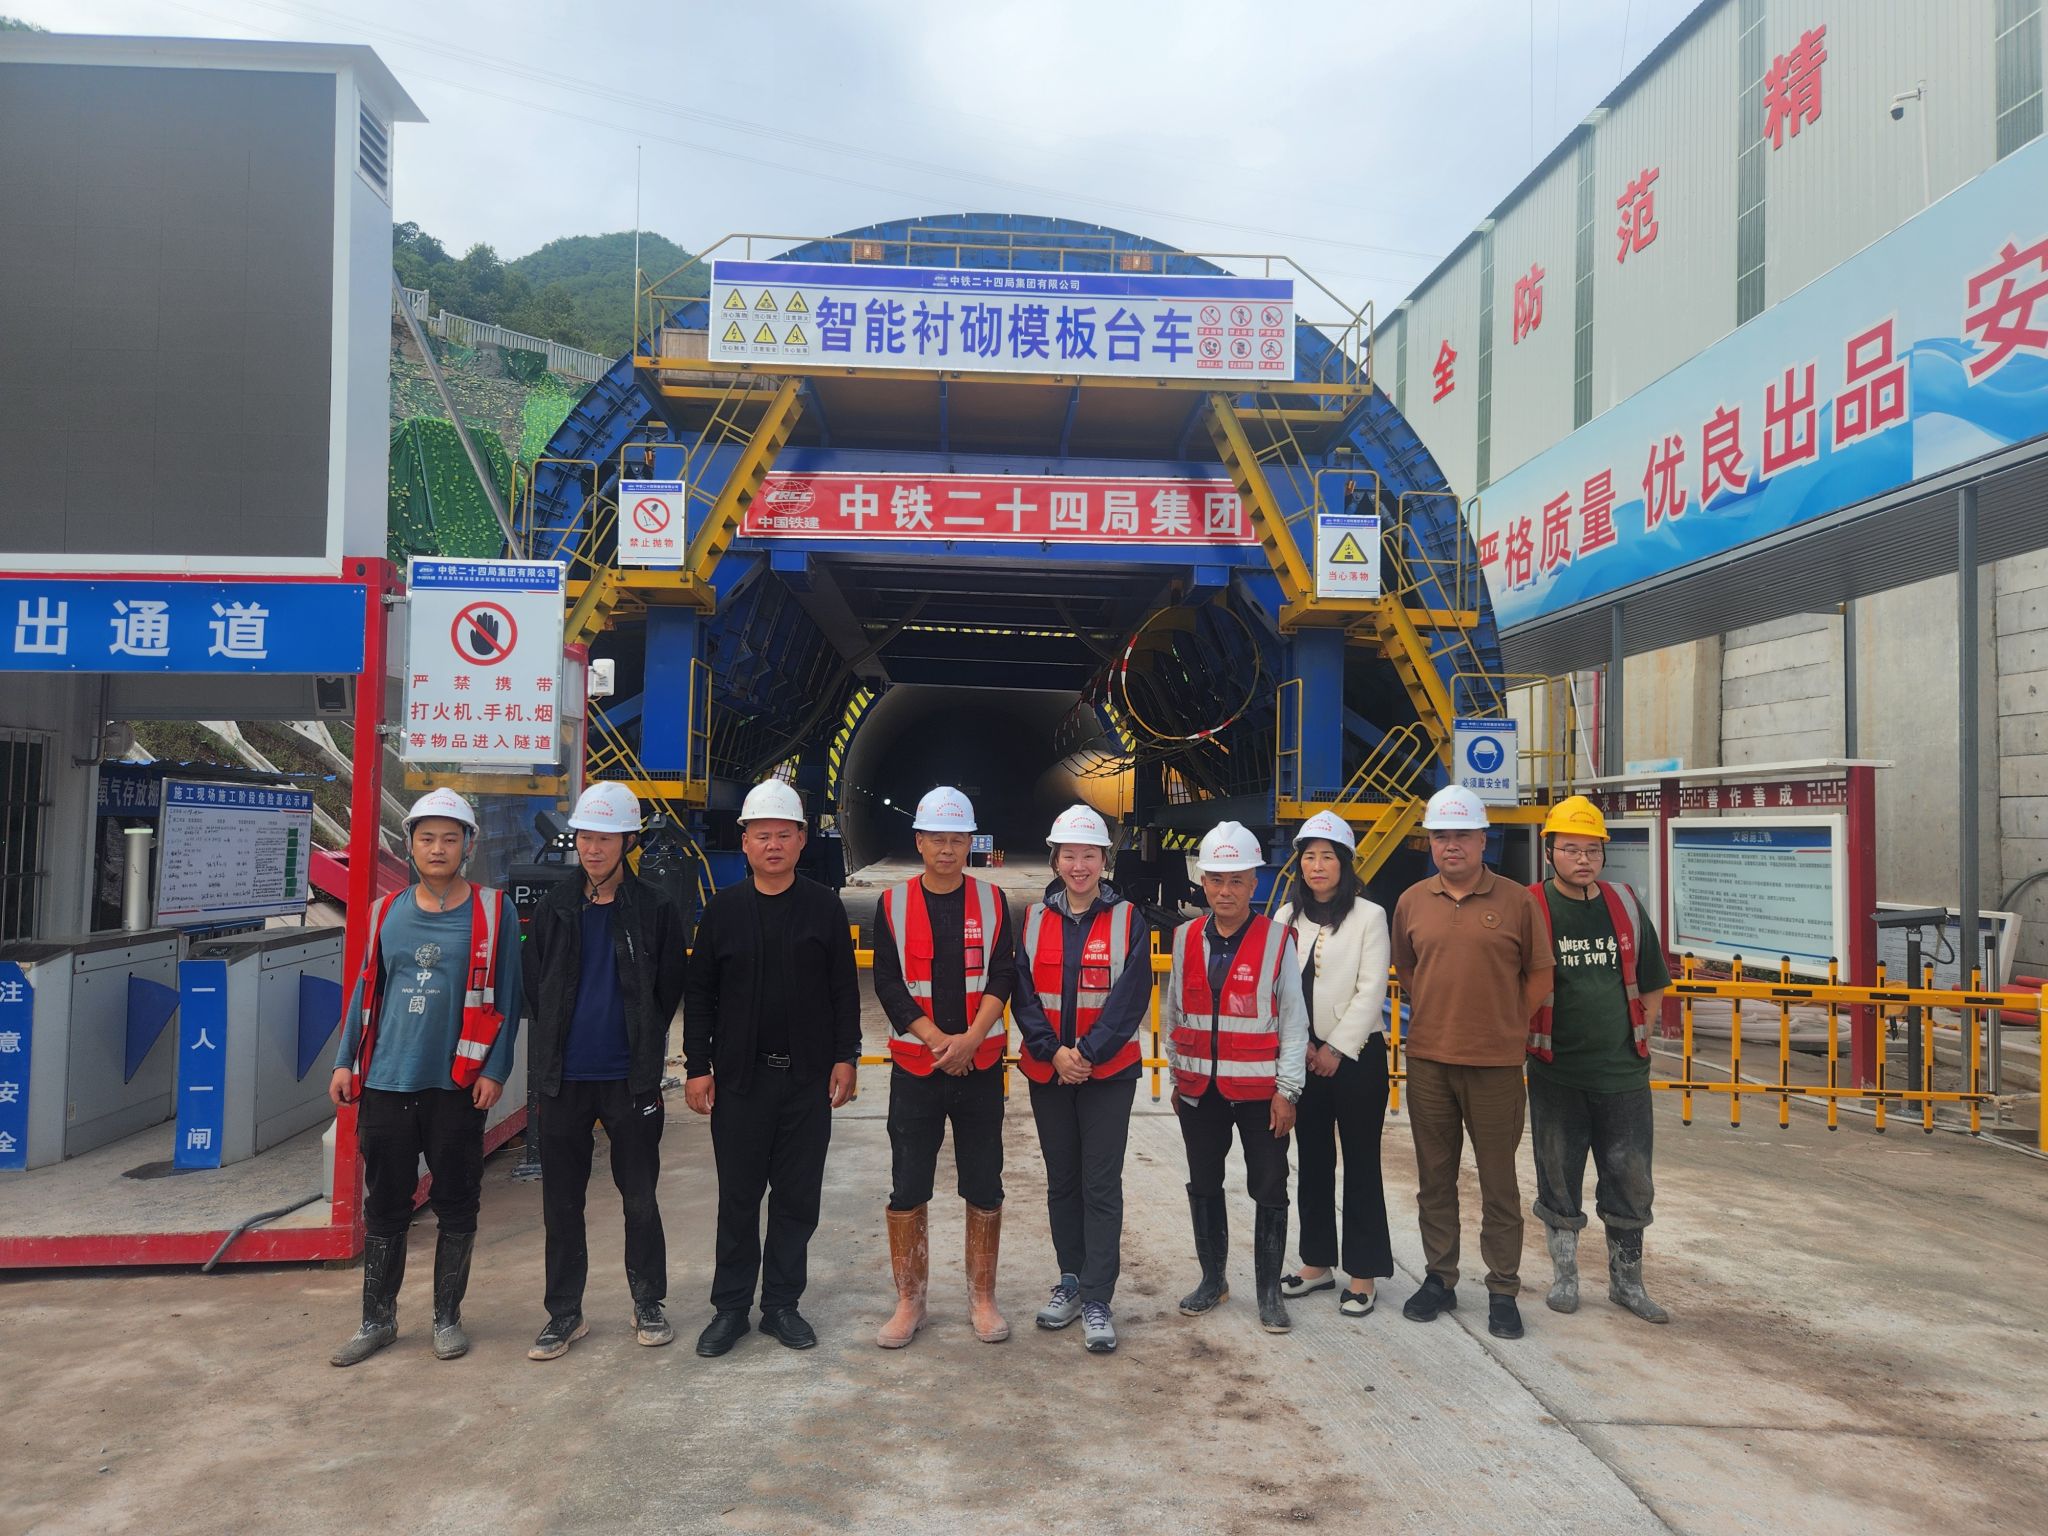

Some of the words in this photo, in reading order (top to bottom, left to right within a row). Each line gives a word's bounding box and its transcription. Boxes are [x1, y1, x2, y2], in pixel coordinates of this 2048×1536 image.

[950, 275, 1080, 291] 中铁二十四局集团有限公司
[815, 295, 1195, 363] 智能衬砌模板台车
[1642, 316, 1906, 527] 优良出品
[1965, 241, 2048, 379] 安
[839, 484, 1242, 536] 中铁二十四局集团
[758, 516, 820, 529] 中国铁建
[438, 565, 556, 578] 中铁二十四局集团有限公司
[14, 597, 269, 659] 出通道
[413, 674, 553, 691] 严禁携带
[411, 701, 553, 722] 打火机、手机、烟
[410, 733, 551, 750] 等物品进入隧道
[1707, 784, 1794, 809] 善作善成
[1558, 936, 1590, 953] WHERE
[1595, 938, 1604, 950] IS
[1561, 954, 1580, 967] THE
[417, 969, 433, 987] 中
[187, 987, 216, 1150] 一人一闸
